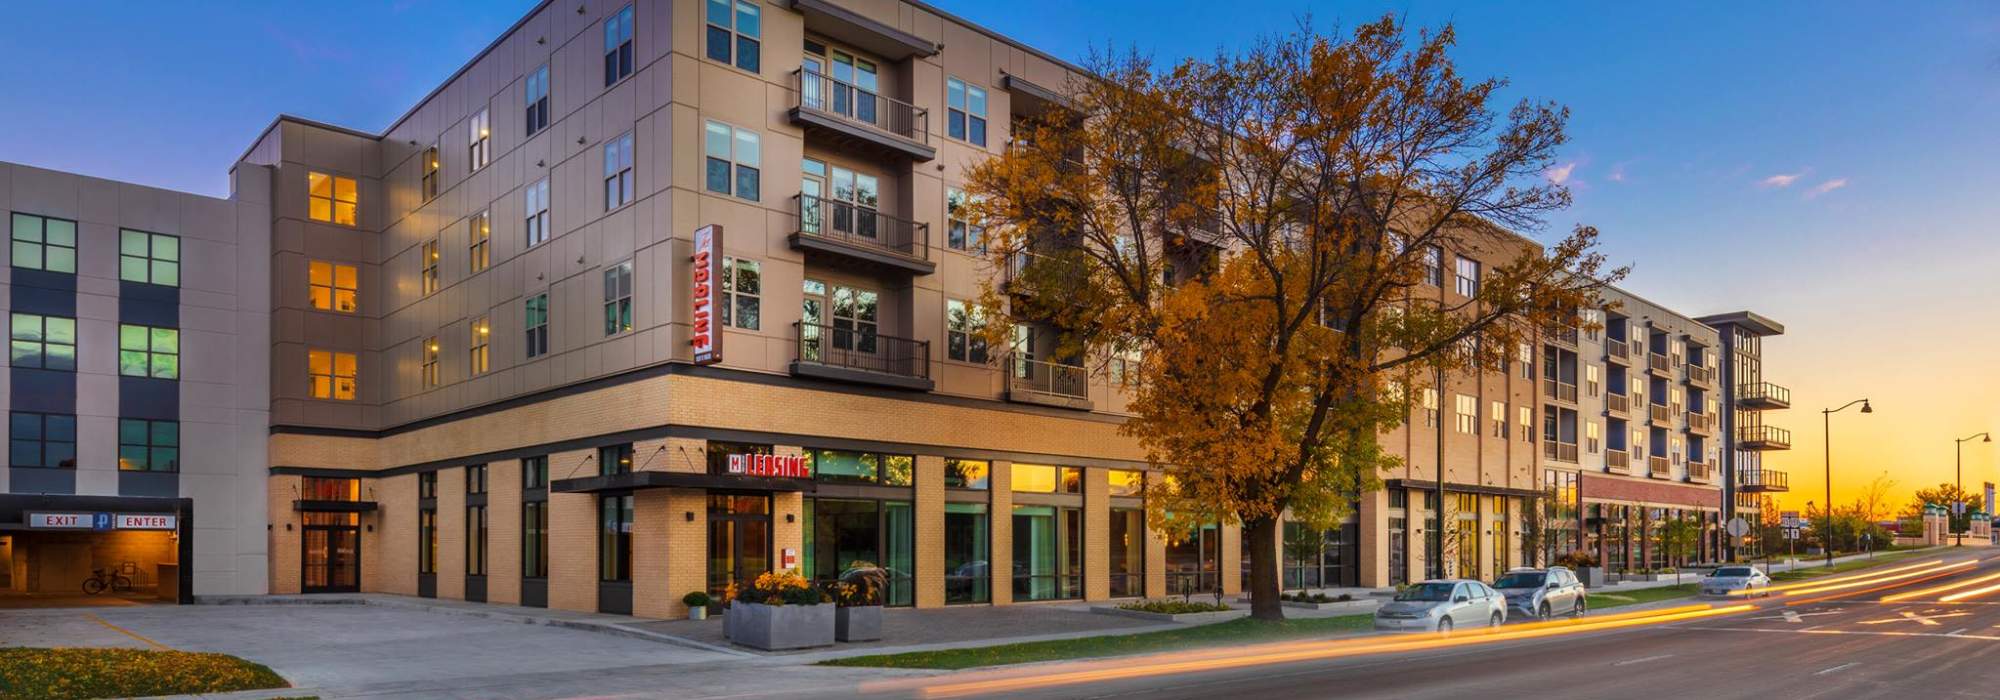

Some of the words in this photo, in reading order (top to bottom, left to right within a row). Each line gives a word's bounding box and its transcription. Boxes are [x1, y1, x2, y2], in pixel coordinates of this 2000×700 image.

[745, 454, 809, 477] LEASING
[46, 516, 78, 526] EXIT
[126, 517, 167, 527] ENTER
